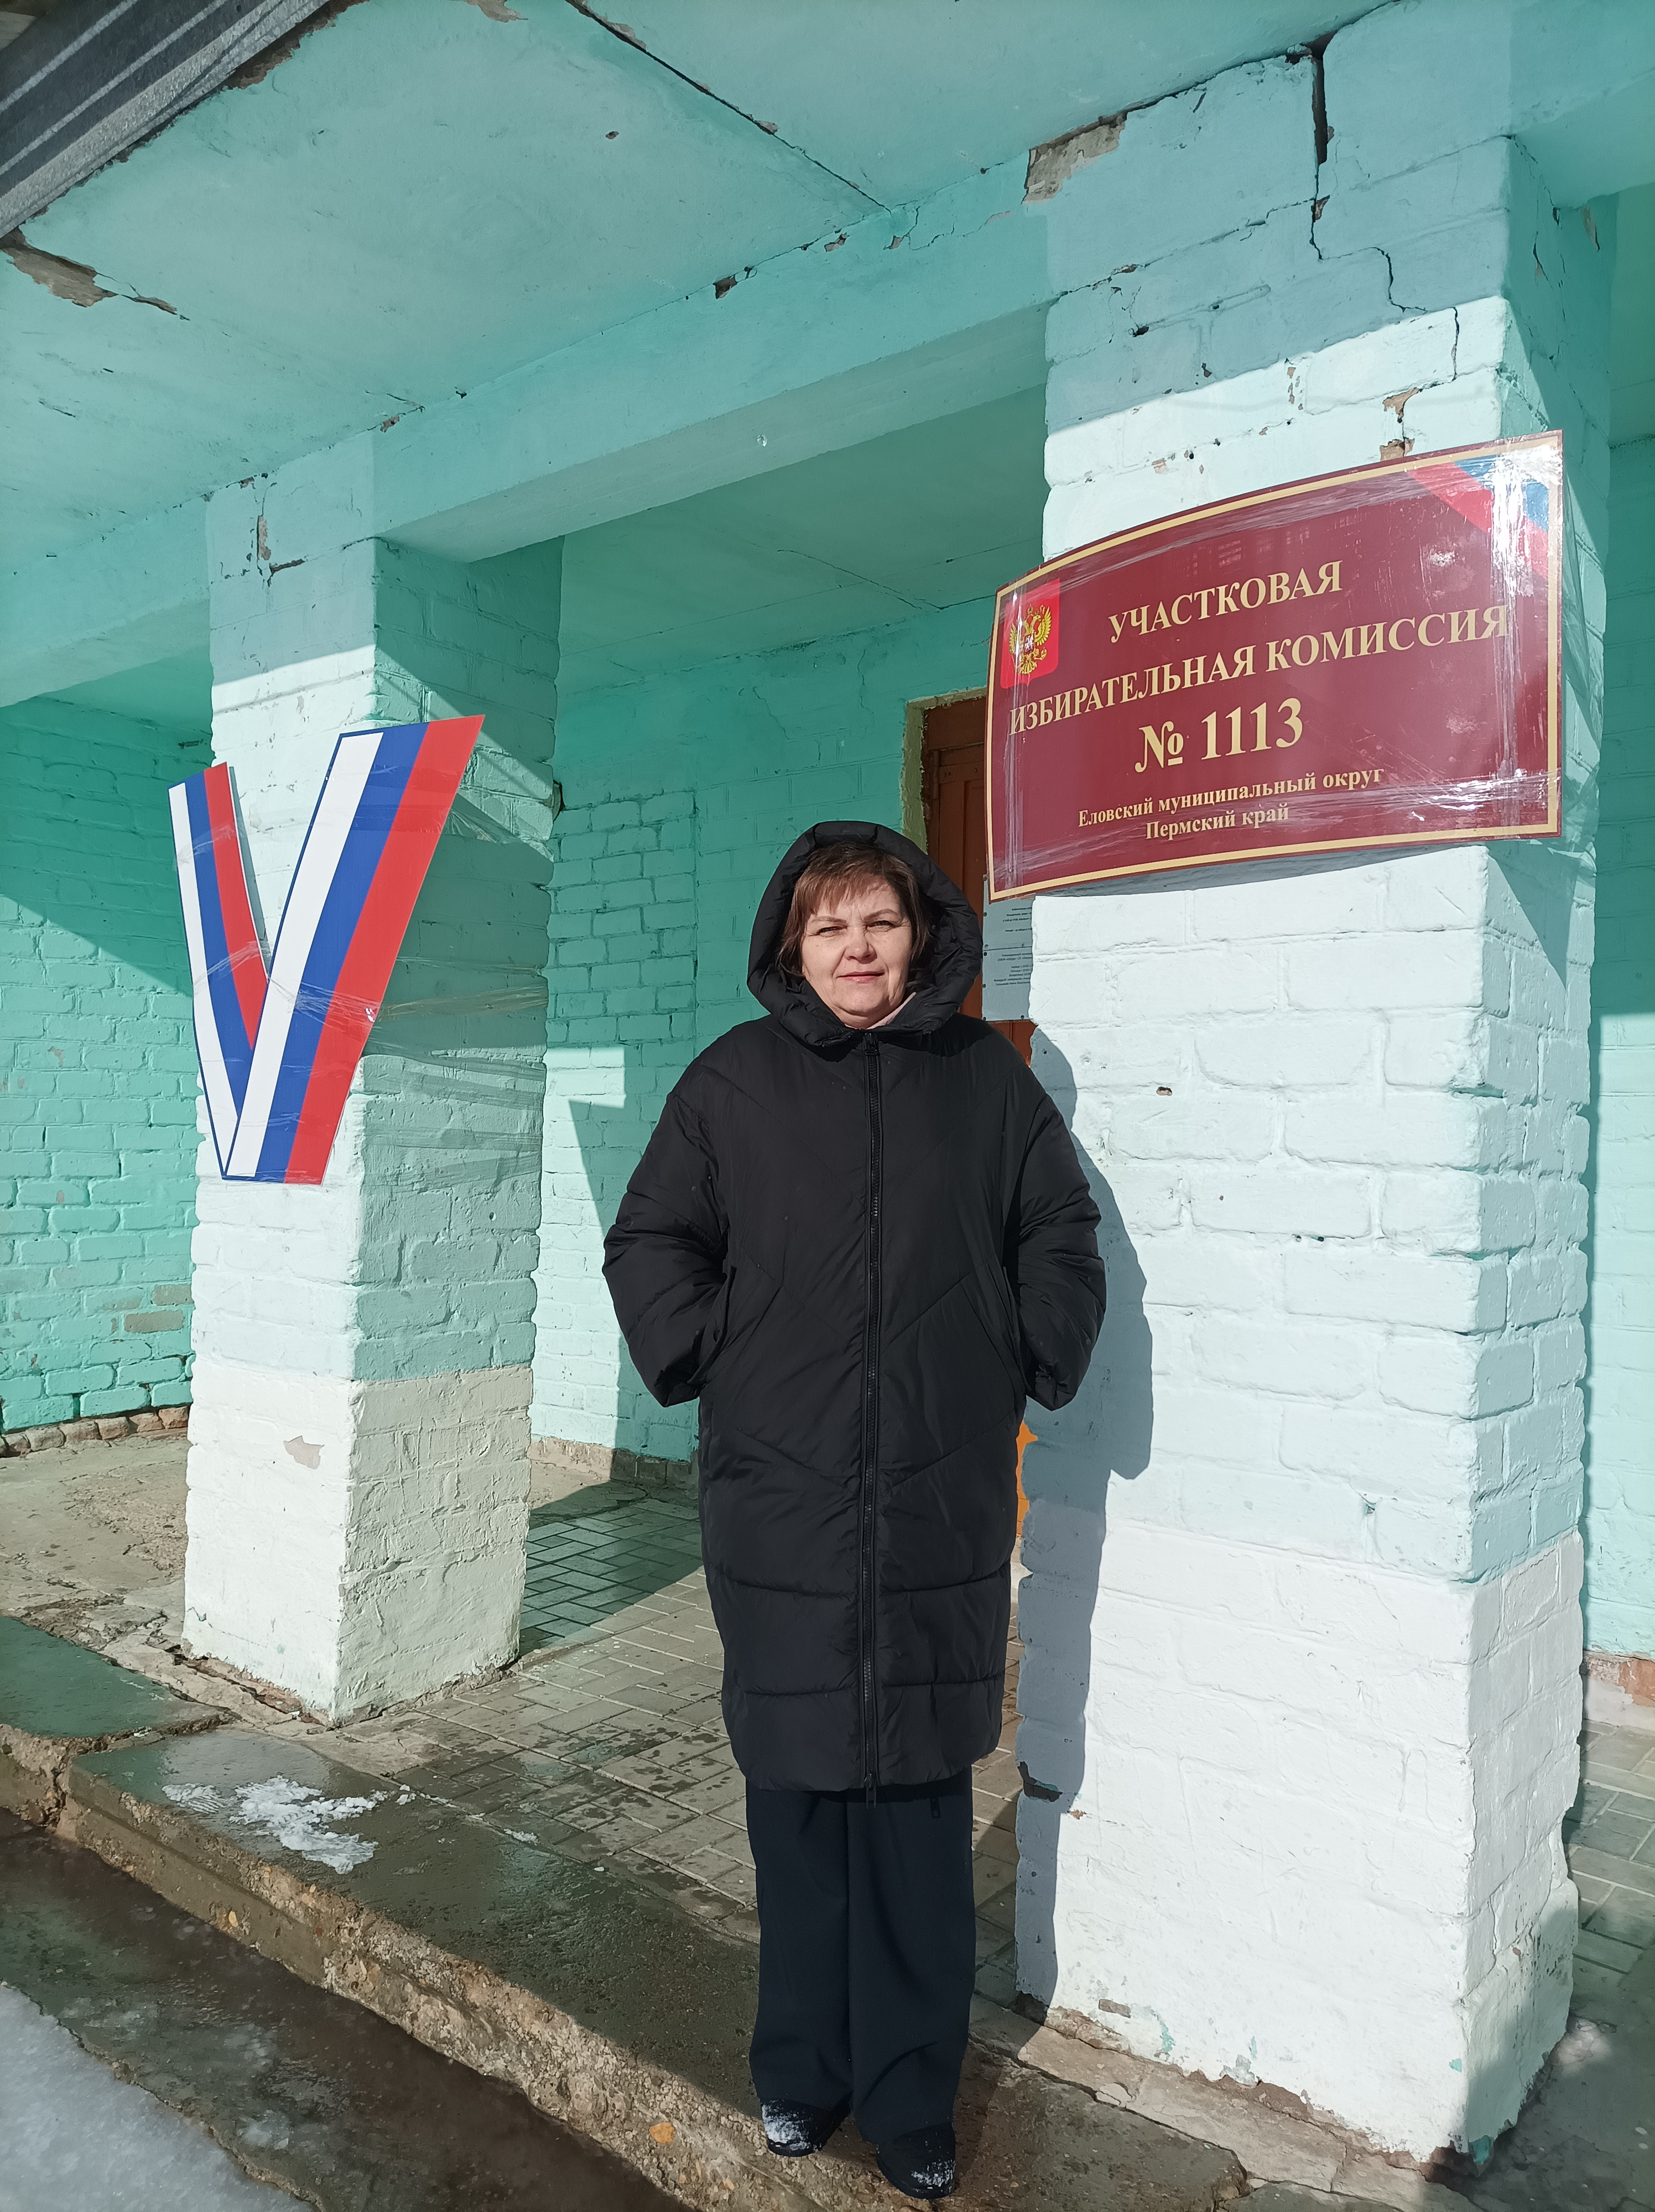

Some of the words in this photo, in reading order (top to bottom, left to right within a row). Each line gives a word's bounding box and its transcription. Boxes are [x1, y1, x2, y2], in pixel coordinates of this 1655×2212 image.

[1108, 560, 1343, 643] УЧАСТКОВАЯ
[1008, 645, 1256, 736] ИЗБИРАТЕЛЬНАЯ
[1265, 604, 1509, 672] КОМИССИЯ
[1134, 721, 1184, 773] №
[1201, 697, 1303, 760] 1113
[1078, 797, 1153, 827] Еловский
[1158, 772, 1316, 814] муниципальный
[1323, 768, 1385, 790] округ
[1145, 809, 1236, 841] Пермский
[1241, 803, 1289, 829] край
